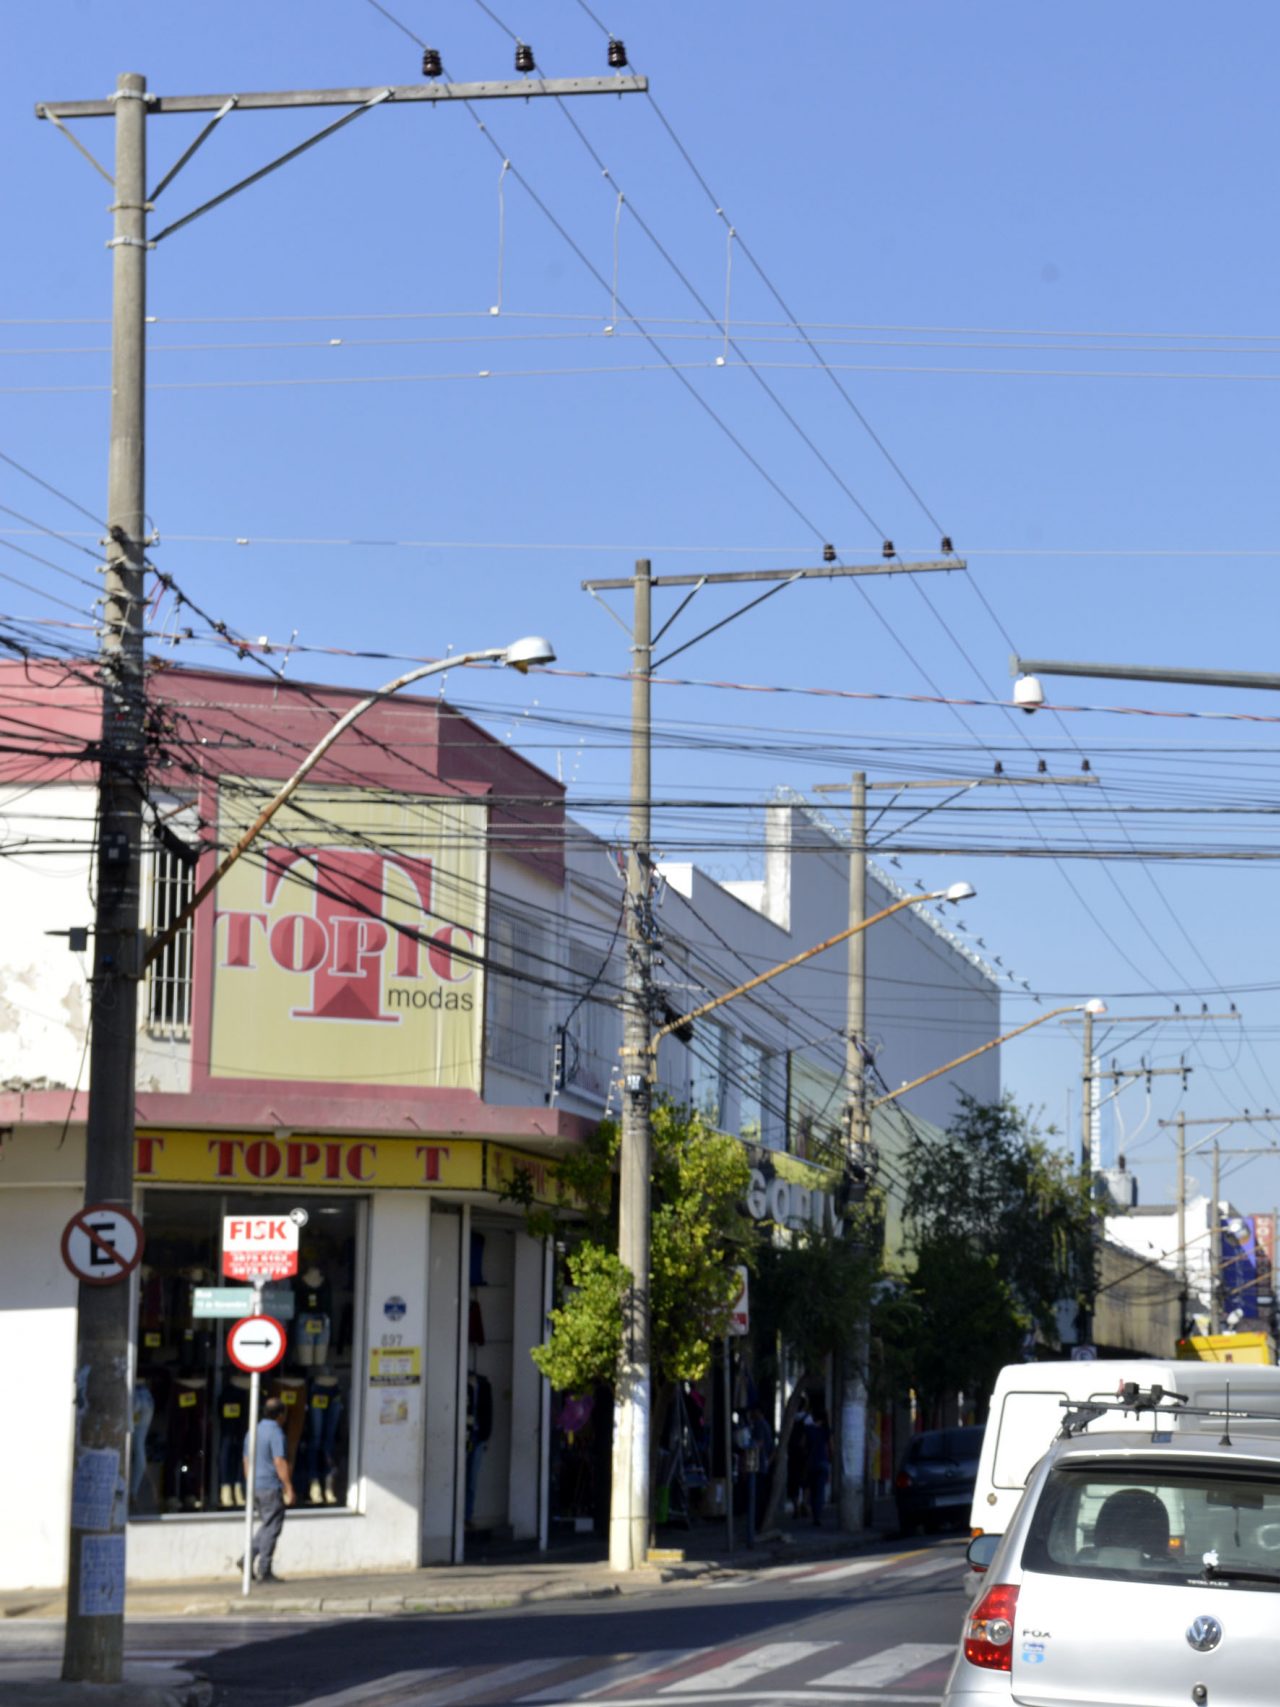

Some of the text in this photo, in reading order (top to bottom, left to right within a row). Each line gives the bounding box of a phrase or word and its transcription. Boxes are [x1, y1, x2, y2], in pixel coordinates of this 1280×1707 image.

[215, 908, 476, 984] TOPIC
[387, 986, 474, 1011] modas
[208, 1139, 377, 1181] TOPIC
[416, 1145, 450, 1182] T
[90, 1222, 116, 1266] E
[229, 1220, 288, 1241] FISK
